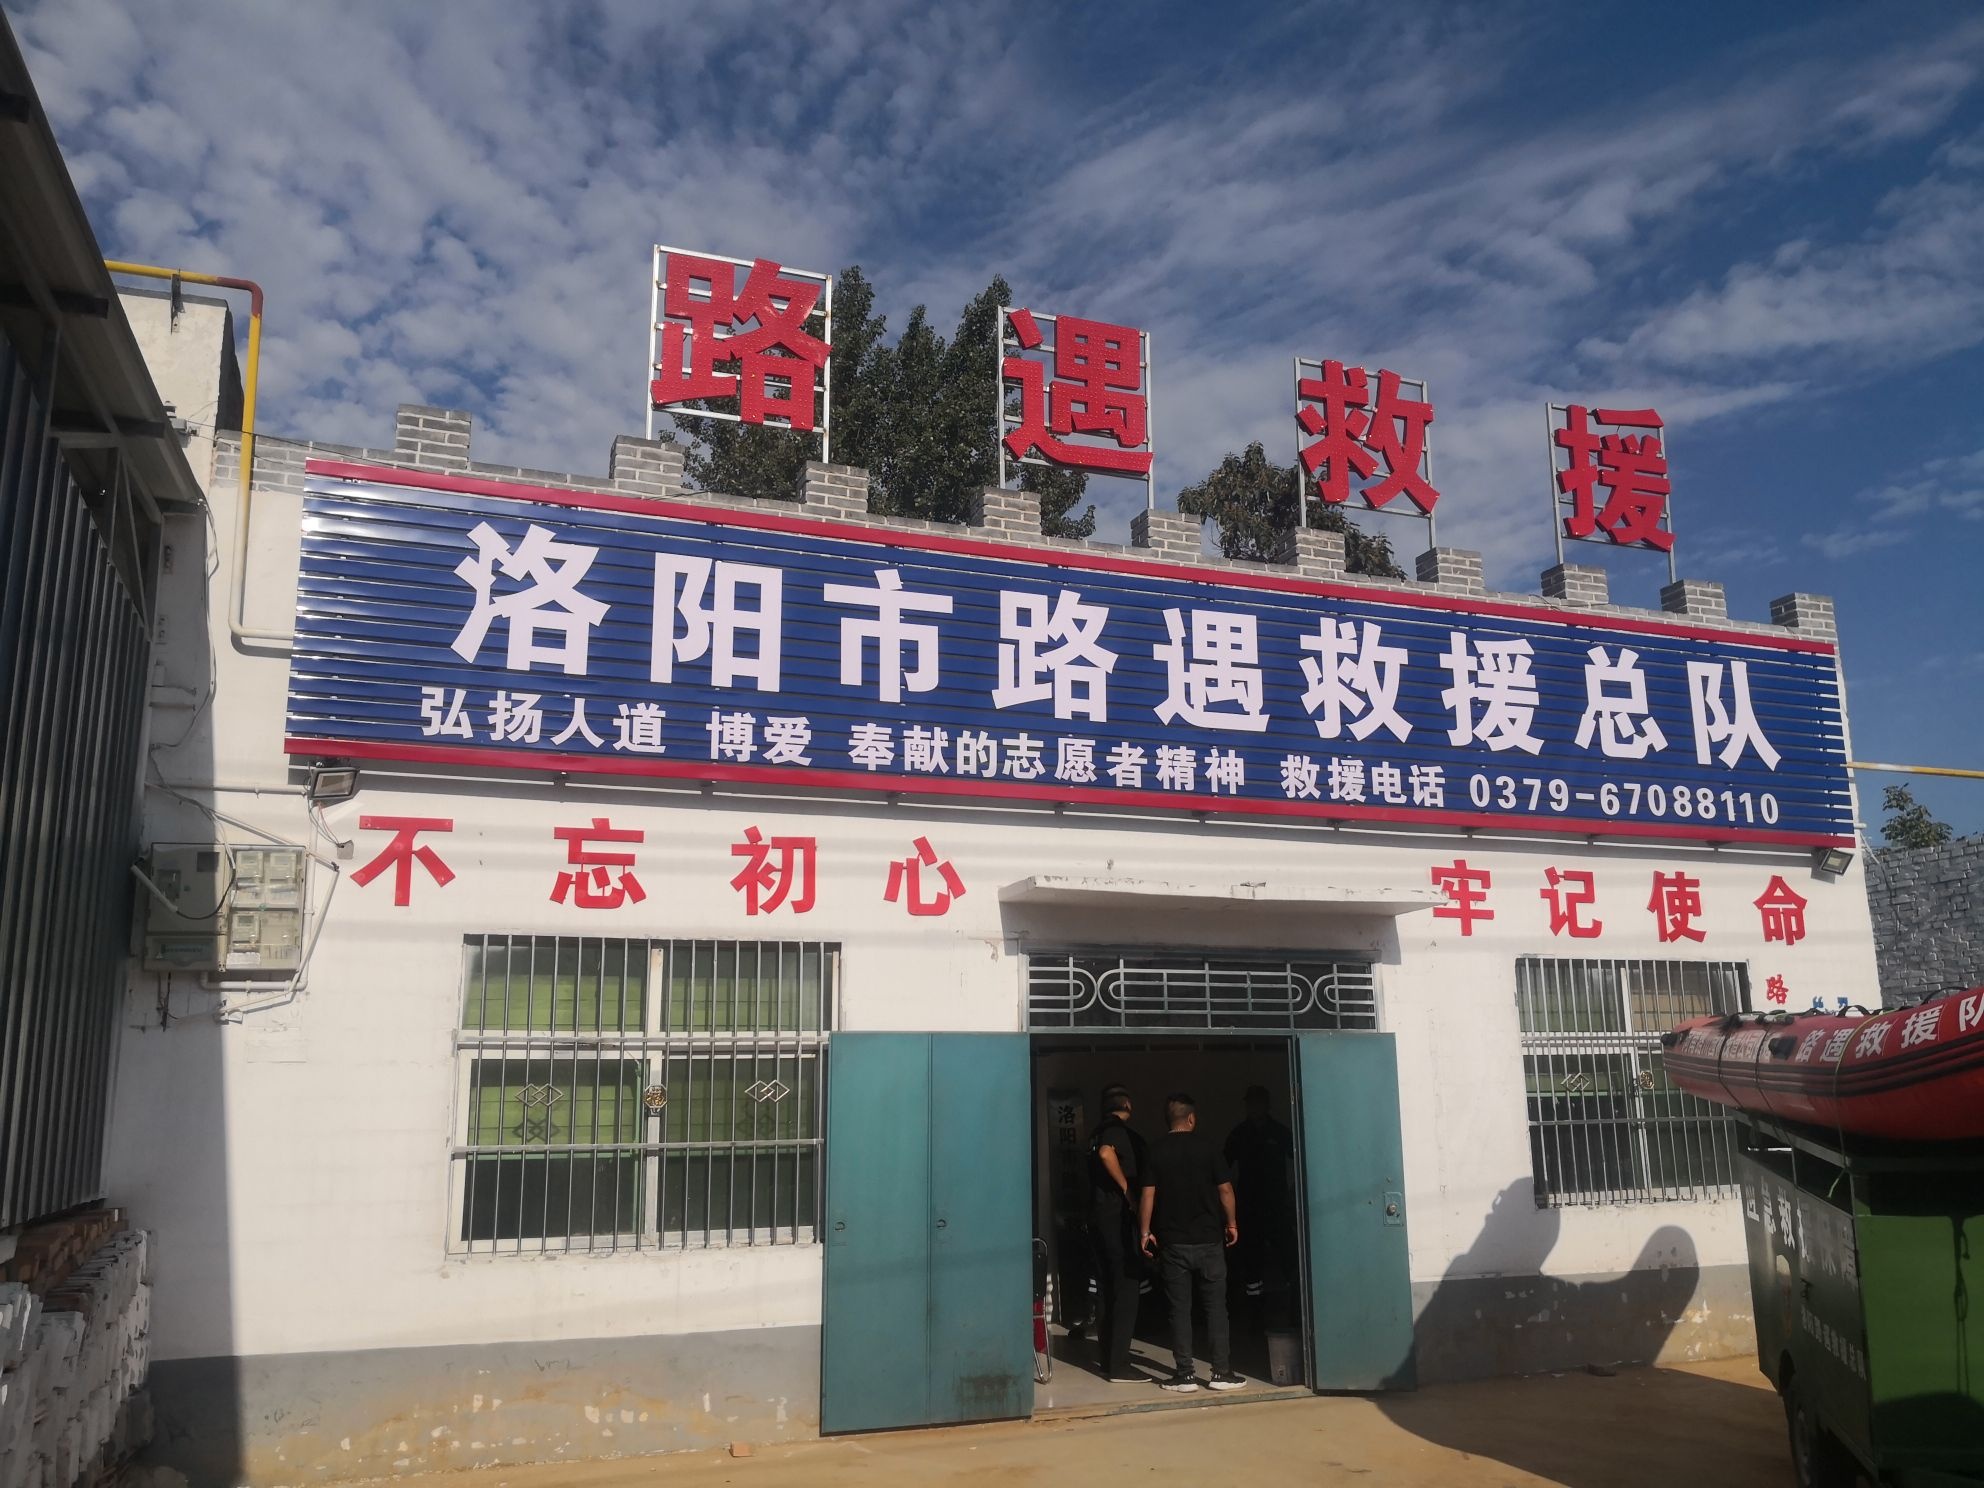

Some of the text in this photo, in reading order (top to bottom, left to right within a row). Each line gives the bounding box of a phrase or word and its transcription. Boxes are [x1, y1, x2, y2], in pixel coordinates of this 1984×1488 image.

[651, 252, 1676, 552] 路遇救援
[451, 520, 1781, 773] 洛阳市路遇救援总队
[420, 686, 1780, 825] 弘扬人道 博爱 奉献的志愿者精神 救援电话 0379-67088110
[350, 814, 967, 917] 不忘初心
[1431, 859, 1808, 946] 牢记使命
